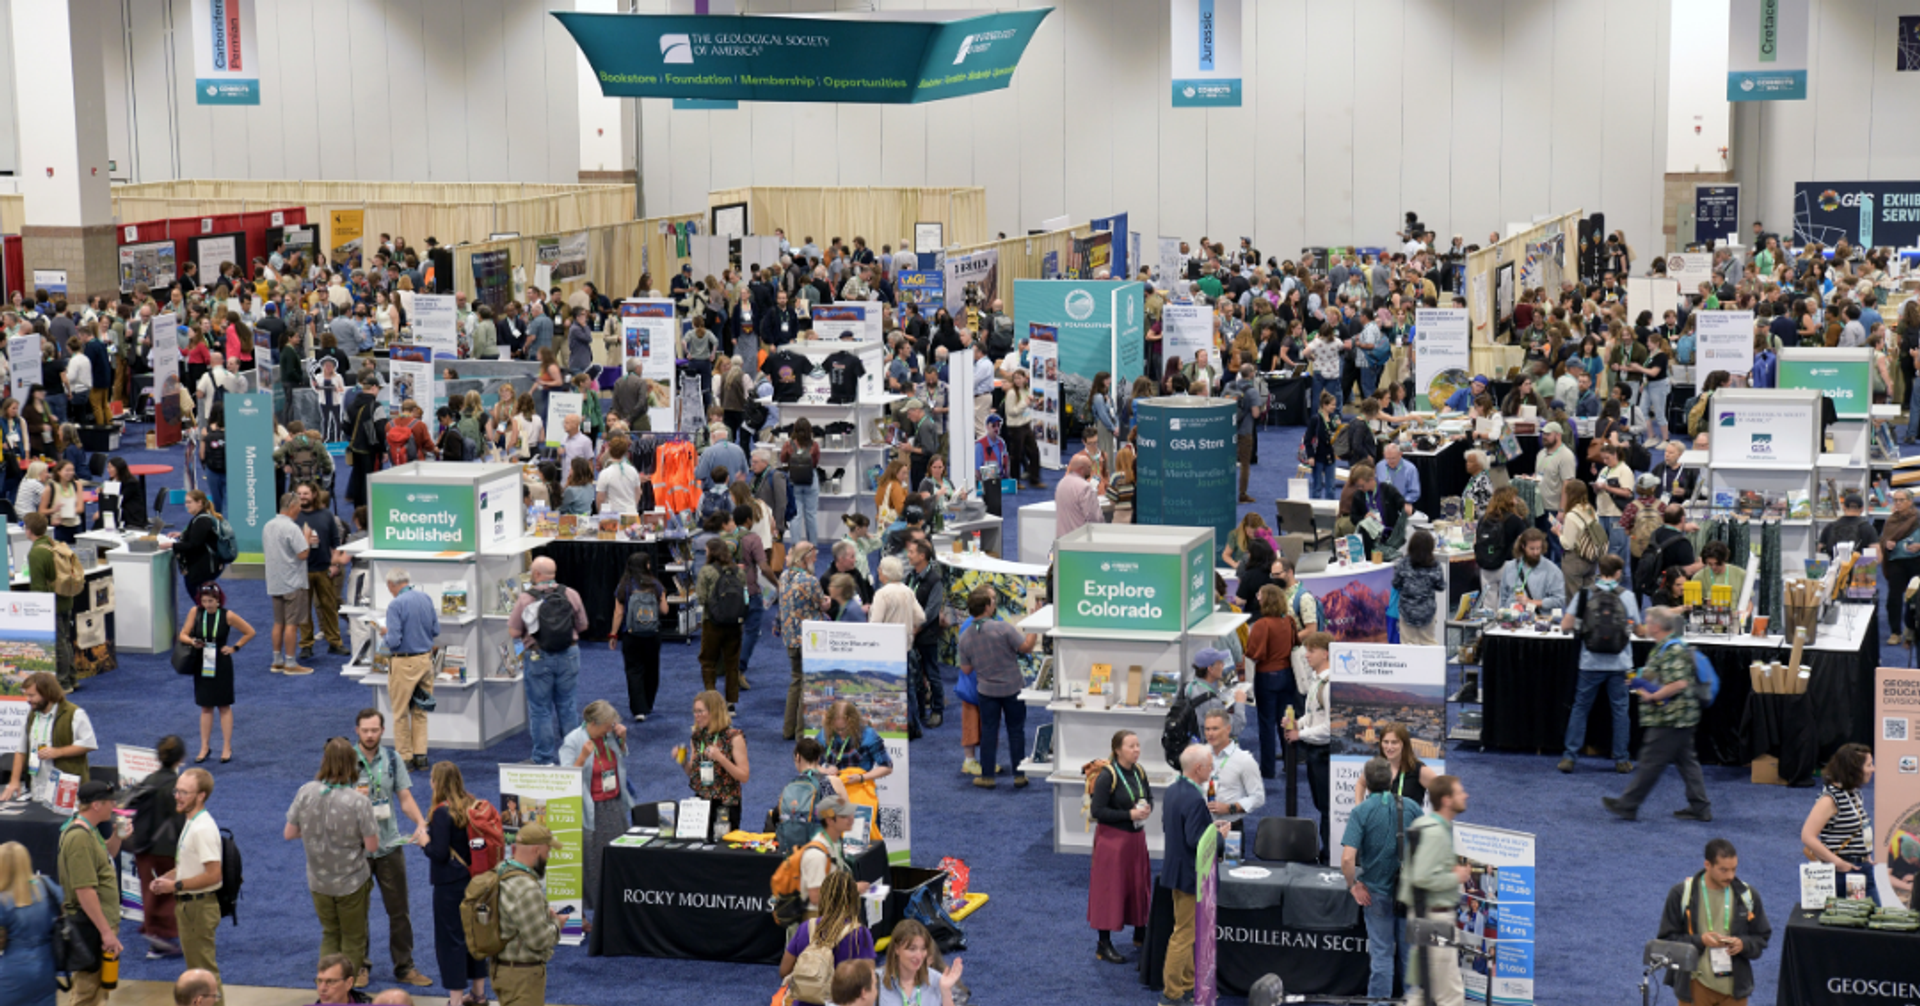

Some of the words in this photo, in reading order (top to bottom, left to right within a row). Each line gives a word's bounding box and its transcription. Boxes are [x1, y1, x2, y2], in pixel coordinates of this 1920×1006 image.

[230, 18, 240, 68] Permian
[691, 34, 712, 44] THE
[717, 34, 784, 45] GEOLOGICAL
[786, 35, 831, 46] SOCIETY
[1200, 11, 1212, 63] Jurassic
[693, 45, 708, 55] OF
[600, 71, 657, 84] Bookstore
[664, 74, 733, 85] Foundation
[740, 74, 815, 88] Membership
[823, 76, 907, 89] Opportunities
[1169, 438, 1196, 450] GSA
[1198, 438, 1225, 450] Store
[1163, 459, 1192, 469] Books
[245, 446, 259, 527] Membership
[389, 508, 458, 527] Recently
[385, 526, 463, 543] Published
[1084, 580, 1156, 600] Explore
[1077, 600, 1163, 619] Colorado
[1361, 667, 1394, 675] Section
[623, 888, 675, 905] ROCKY
[678, 892, 763, 912] MOUNTAIN
[1215, 925, 1317, 949] ORDILLERAN
[1322, 934, 1369, 954] SECTI
[1827, 977, 1920, 999] GEOSCIEN
